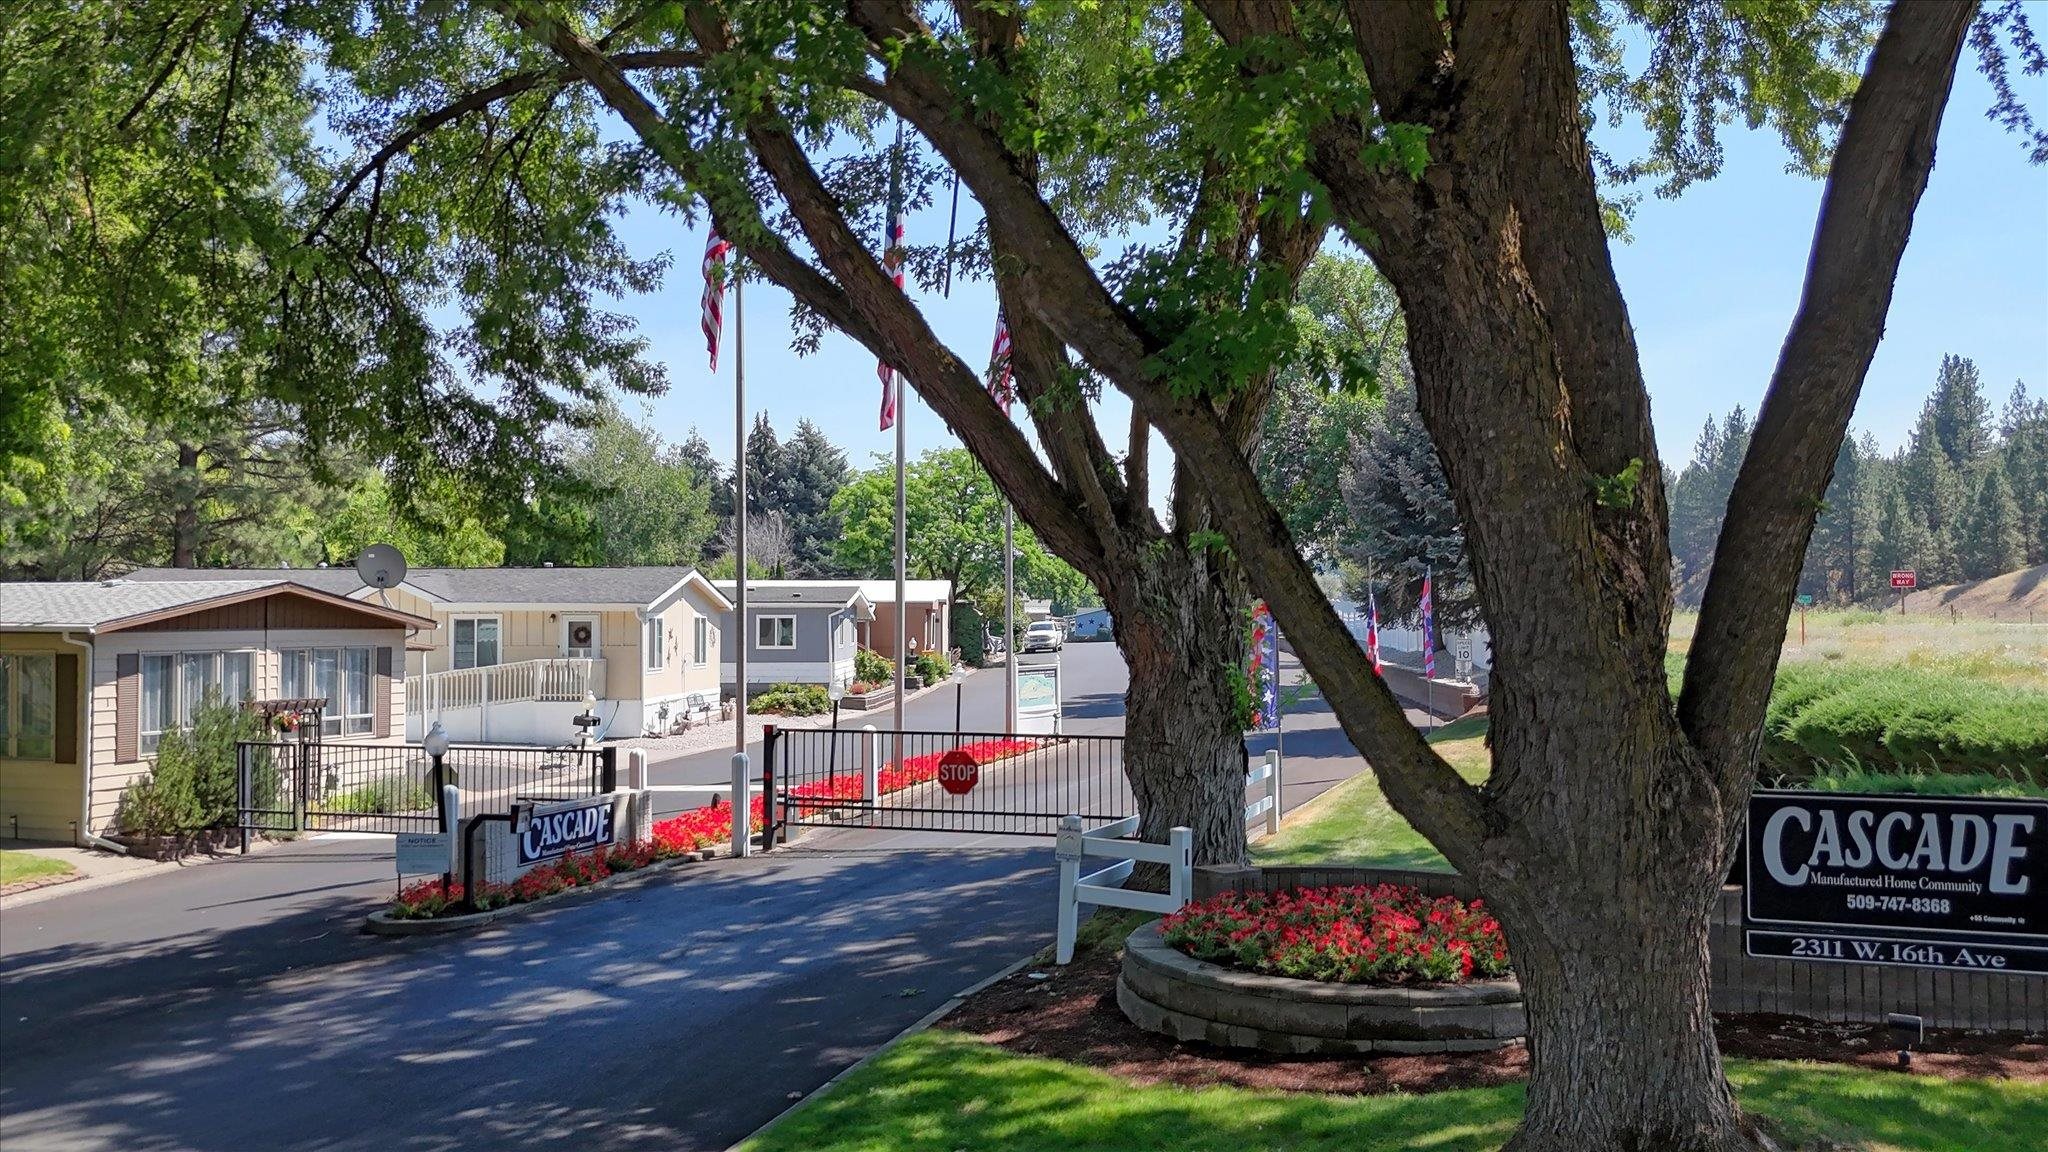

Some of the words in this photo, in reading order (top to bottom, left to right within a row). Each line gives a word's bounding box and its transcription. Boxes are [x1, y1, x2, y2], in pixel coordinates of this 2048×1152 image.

[1458, 651, 1470, 659] 10
[940, 764, 976, 781] STOP
[523, 804, 612, 859] CASCADE
[1762, 806, 2035, 894] CASCADE
[1810, 871, 1883, 888] Manufactured
[1884, 875, 1917, 889] Home
[1919, 877, 1983, 895] Community
[1846, 894, 1950, 914] 509-747-8368
[1791, 938, 1844, 957] 2311
[1851, 941, 1885, 960] W.
[1890, 944, 1944, 964] 16th
[1952, 948, 2006, 968] Ave
